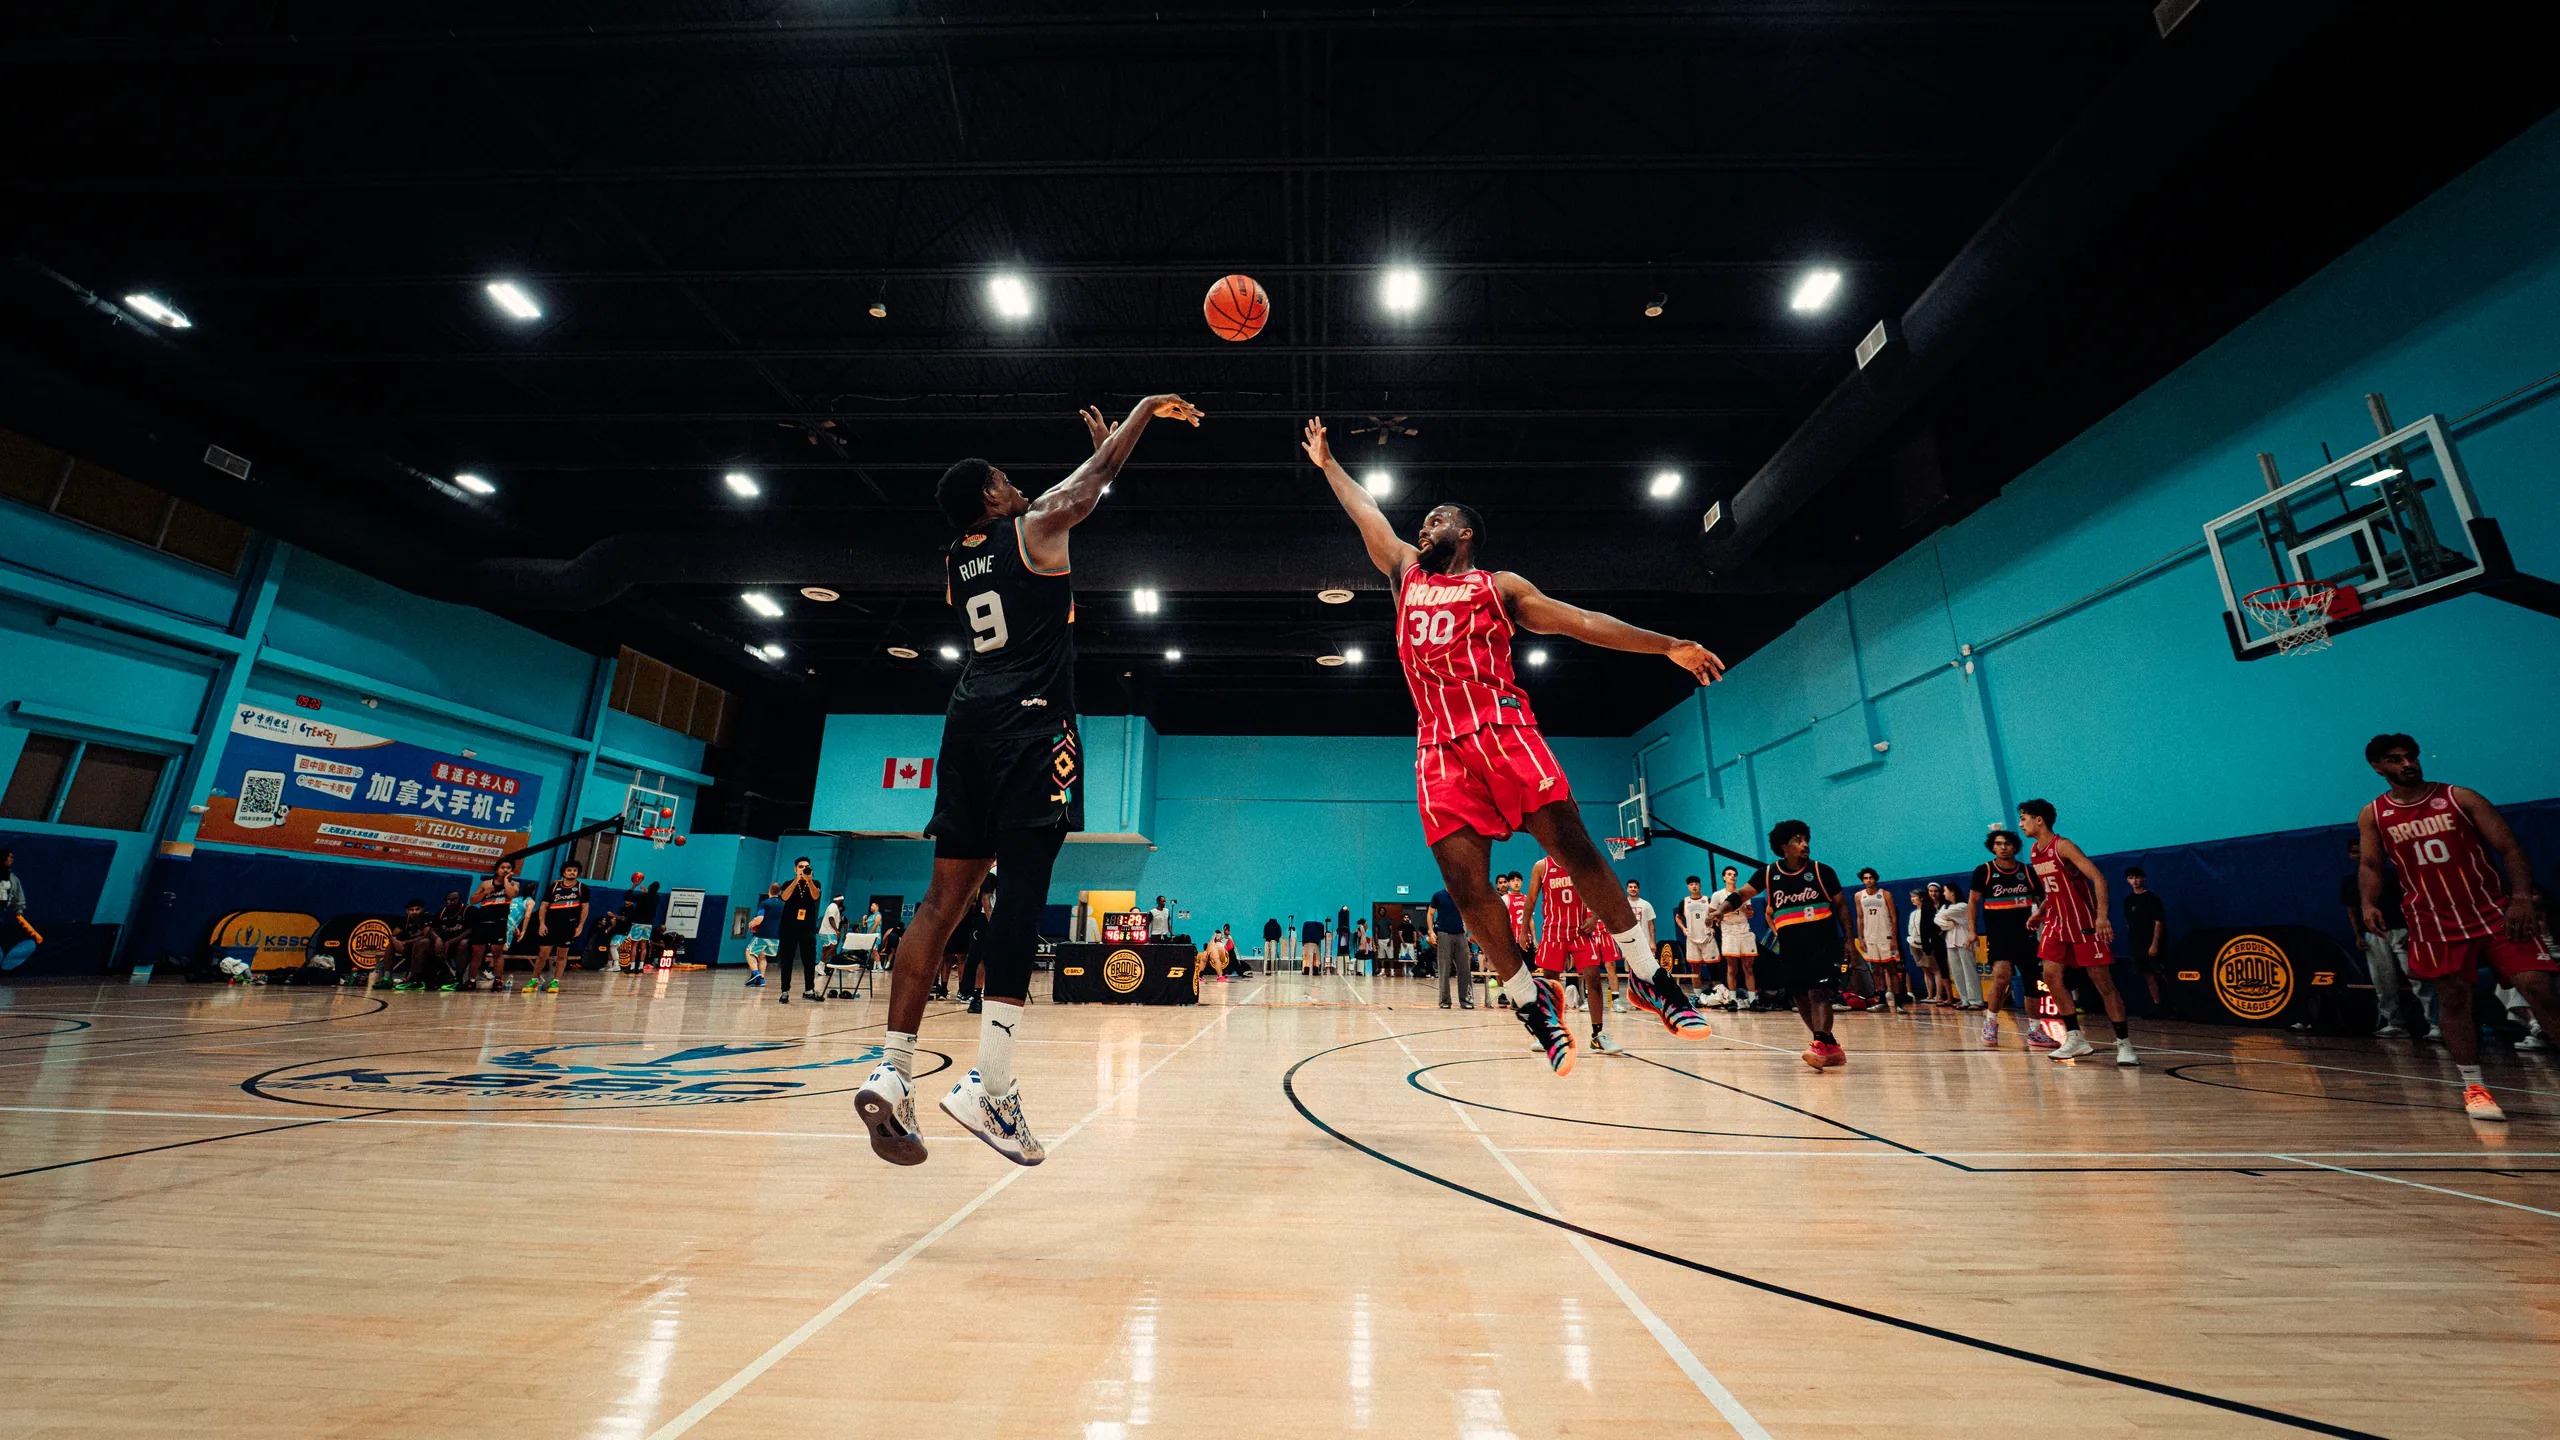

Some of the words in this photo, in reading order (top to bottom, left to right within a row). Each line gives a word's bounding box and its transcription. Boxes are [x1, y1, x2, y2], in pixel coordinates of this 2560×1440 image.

[959, 555, 995, 581] ROWE
[1405, 582, 1479, 606] BRODIE
[966, 590, 1009, 653] 9
[1409, 610, 1455, 646] 30
[436, 764, 516, 794] 最适合华人的
[366, 772, 516, 824] 加拿大手机卡
[427, 823, 466, 839] TELUS
[2387, 813, 2456, 844] BRODIE
[2413, 839, 2451, 865] 10
[1992, 884, 2028, 897] Brodie
[2043, 876, 2059, 893] 15
[1562, 889, 1572, 904] 0
[1773, 887, 1819, 908] Brodie
[1803, 906, 1815, 920] 8
[1107, 931, 1120, 941] 46
[1133, 931, 1147, 941] 49
[2234, 942, 2267, 953] BRODIE
[1111, 961, 1138, 976] BRODIE
[2225, 957, 2281, 985] BRODIE
[2236, 1001, 2271, 1012] LEAGUE
[281, 1069, 806, 1095] KSSC
